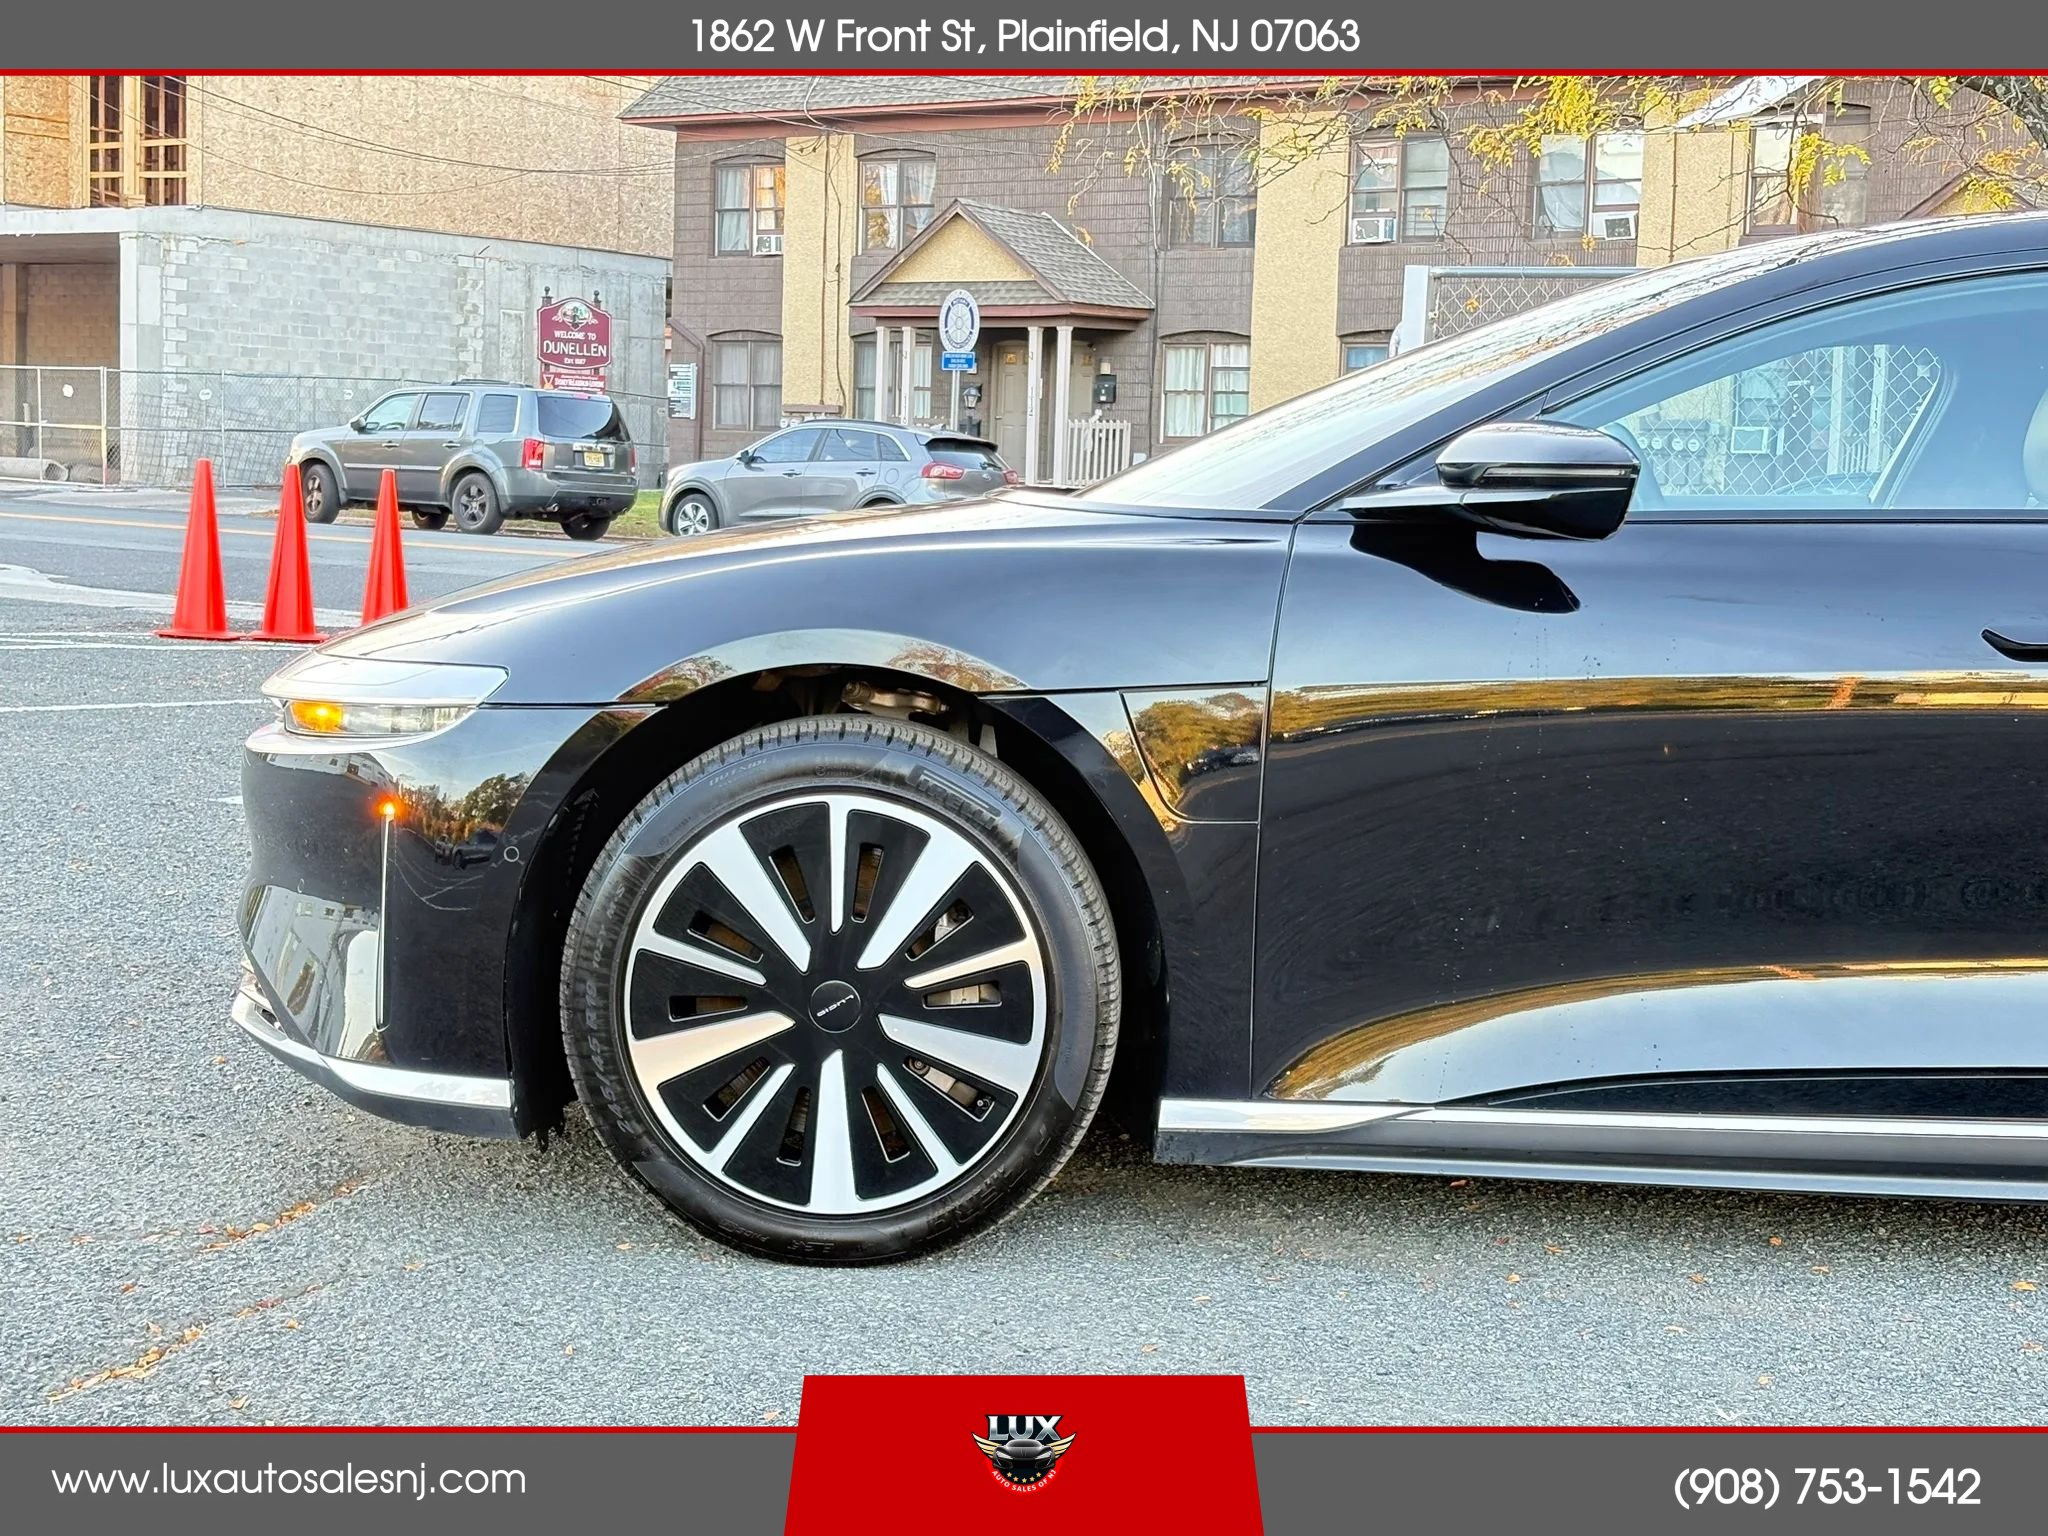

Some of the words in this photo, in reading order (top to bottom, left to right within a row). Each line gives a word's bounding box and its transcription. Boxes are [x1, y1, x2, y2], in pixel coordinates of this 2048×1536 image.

[554, 330, 586, 340] WELCOME
[587, 332, 597, 341] TO
[543, 340, 607, 357] DUNELLEN
[816, 994, 855, 1018] LUCID
[585, 1034, 633, 1135] 245/45
